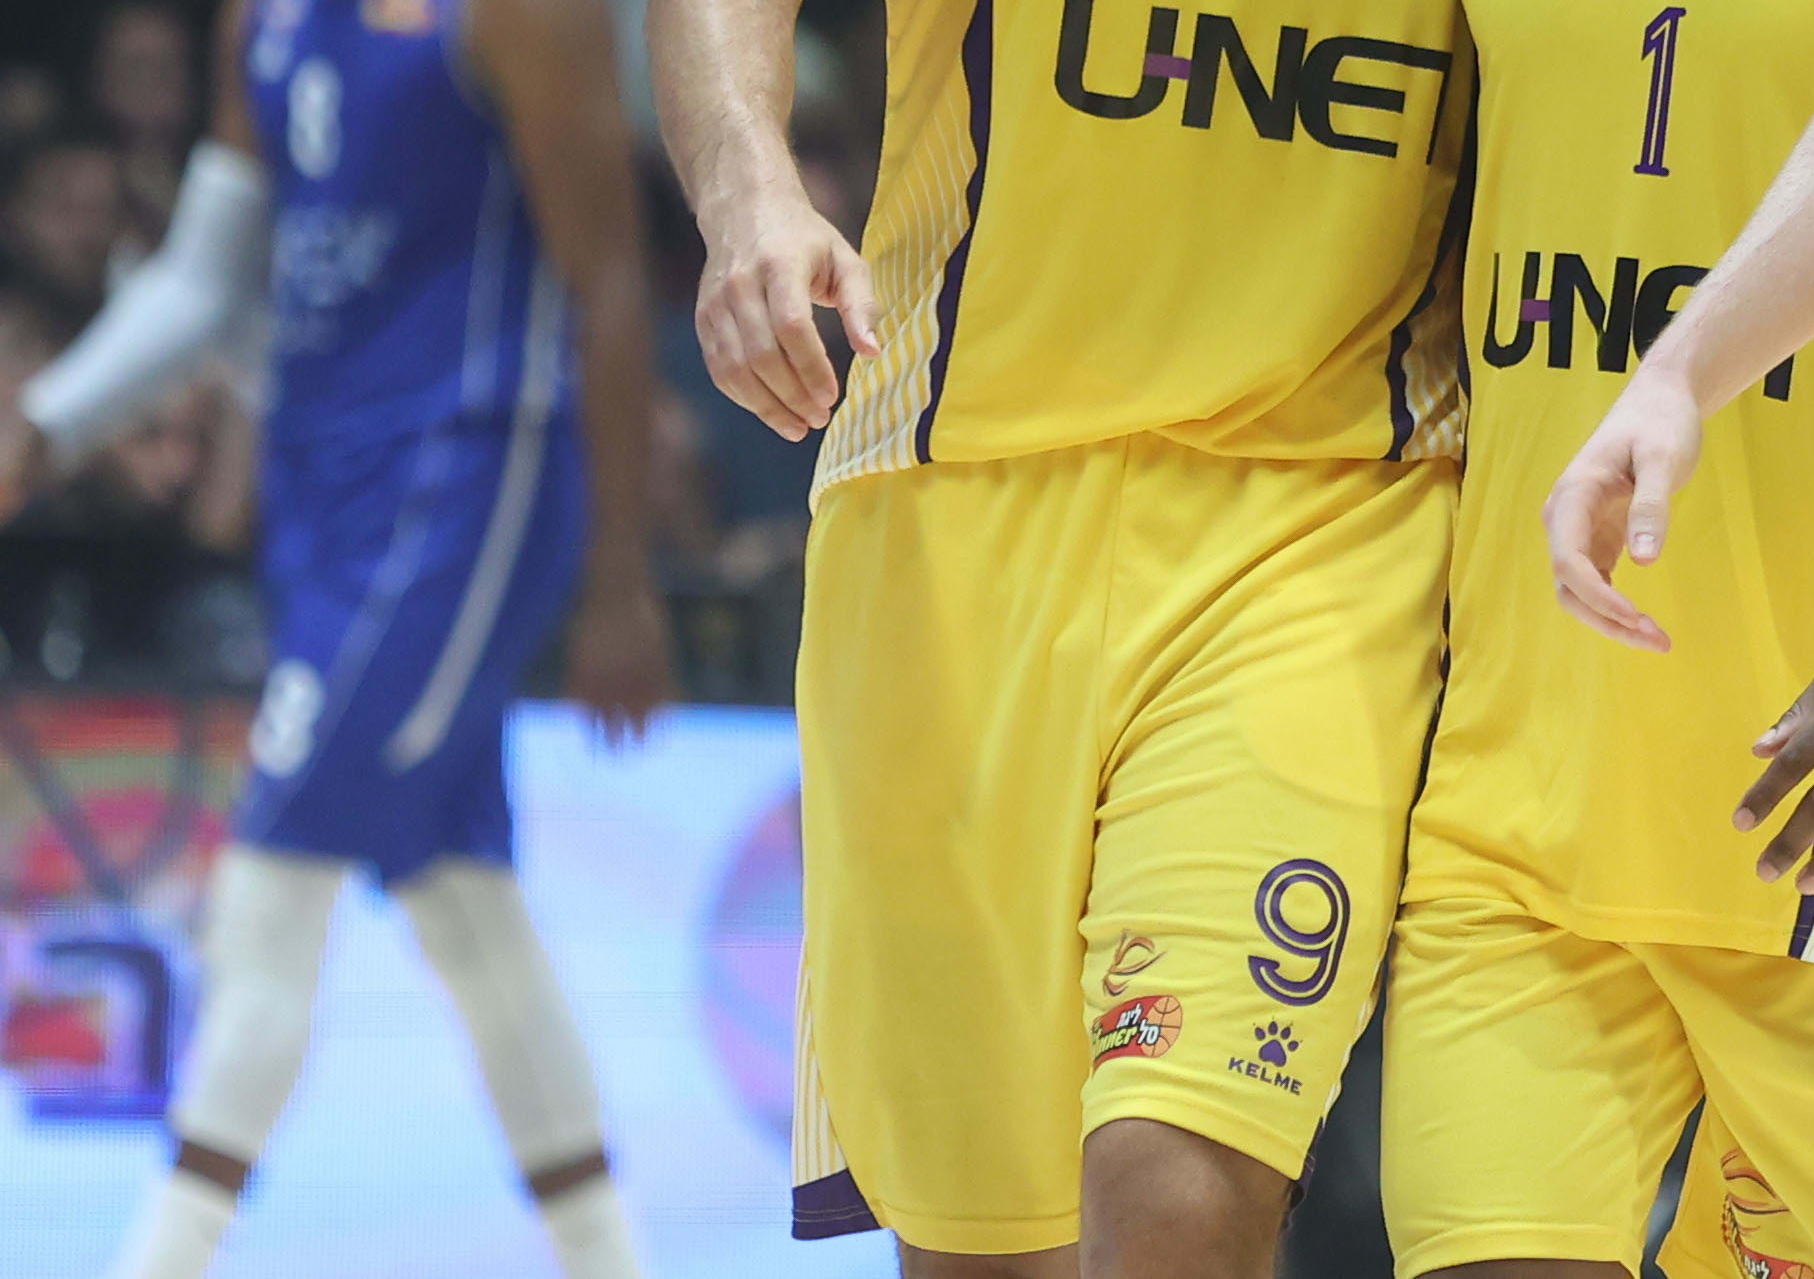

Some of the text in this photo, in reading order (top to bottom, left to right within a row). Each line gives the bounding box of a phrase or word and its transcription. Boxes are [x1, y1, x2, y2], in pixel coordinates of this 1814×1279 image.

[1633, 6, 1687, 177] 1
[1248, 858, 1351, 1007] 9
[1228, 1056, 1303, 1096] KELME
